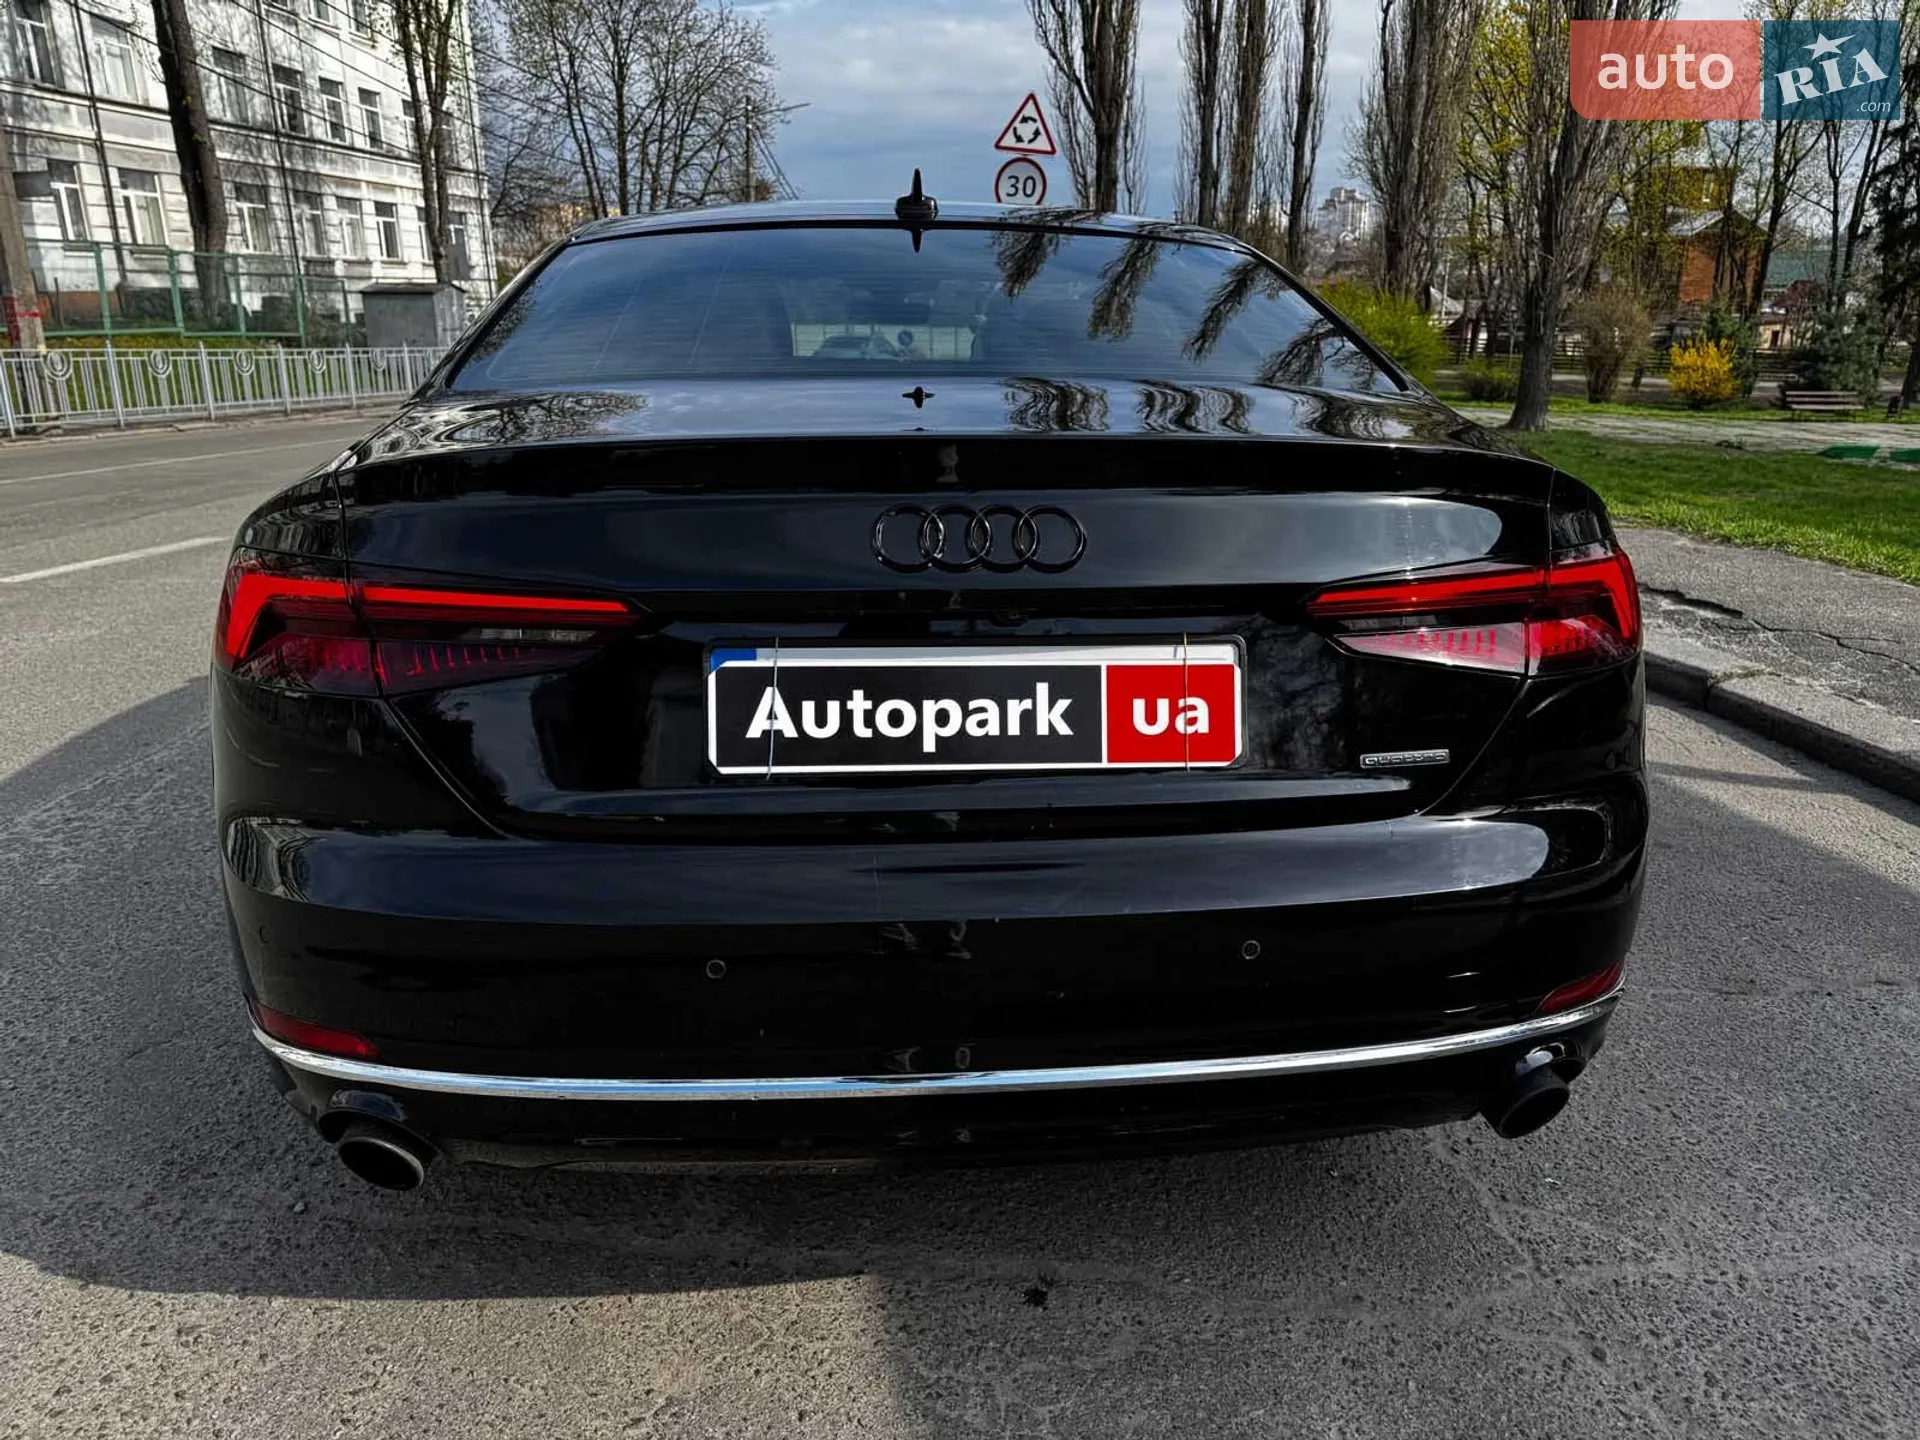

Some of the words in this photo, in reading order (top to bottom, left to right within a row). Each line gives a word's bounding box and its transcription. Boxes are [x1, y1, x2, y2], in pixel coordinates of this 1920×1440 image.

[1006, 175, 1036, 198] 30
[745, 682, 1074, 753] Autopark
[1132, 695, 1210, 735] ua
